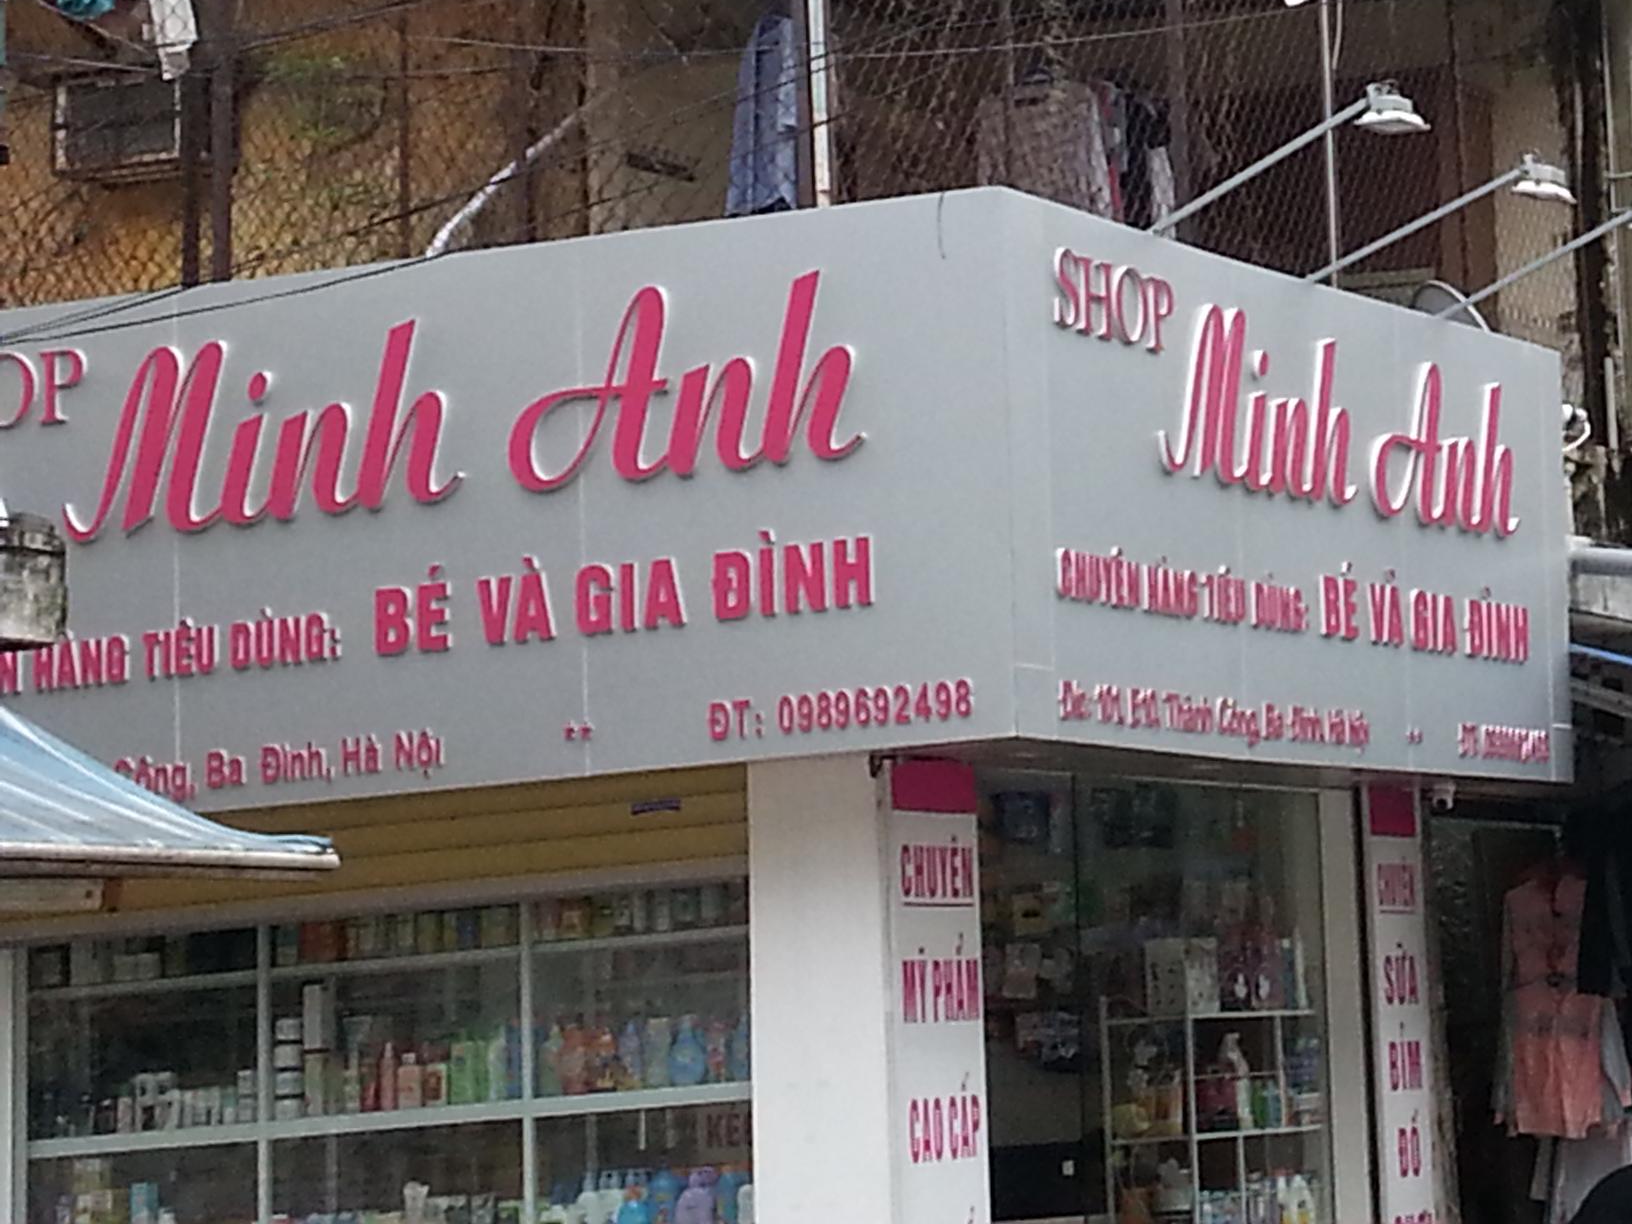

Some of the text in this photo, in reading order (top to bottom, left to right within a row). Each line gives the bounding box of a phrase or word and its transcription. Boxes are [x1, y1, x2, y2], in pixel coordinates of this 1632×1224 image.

[63, 319, 466, 543] Minh
[508, 270, 866, 493] Anh
[1053, 246, 1520, 539] SHOP Minh Anh
[33, 630, 129, 692] HÀNG
[142, 615, 219, 679] TIÊU
[374, 562, 452, 657] BÉ
[476, 555, 557, 646] VÀ
[573, 557, 687, 637] GIA
[713, 530, 875, 622] ĐÌNH
[1320, 561, 1359, 641] BÉ
[1368, 568, 1404, 648] VÀ
[1409, 588, 1458, 657] GIA
[1464, 586, 1528, 665] ĐÌNH
[206, 747, 247, 790] Ba
[340, 733, 382, 774] Hà
[394, 727, 444, 779] Nội
[708, 699, 764, 741] ĐT:
[777, 677, 973, 735] 0989692498
[901, 835, 974, 898] CHUYÊN
[909, 1097, 944, 1163] CAO
